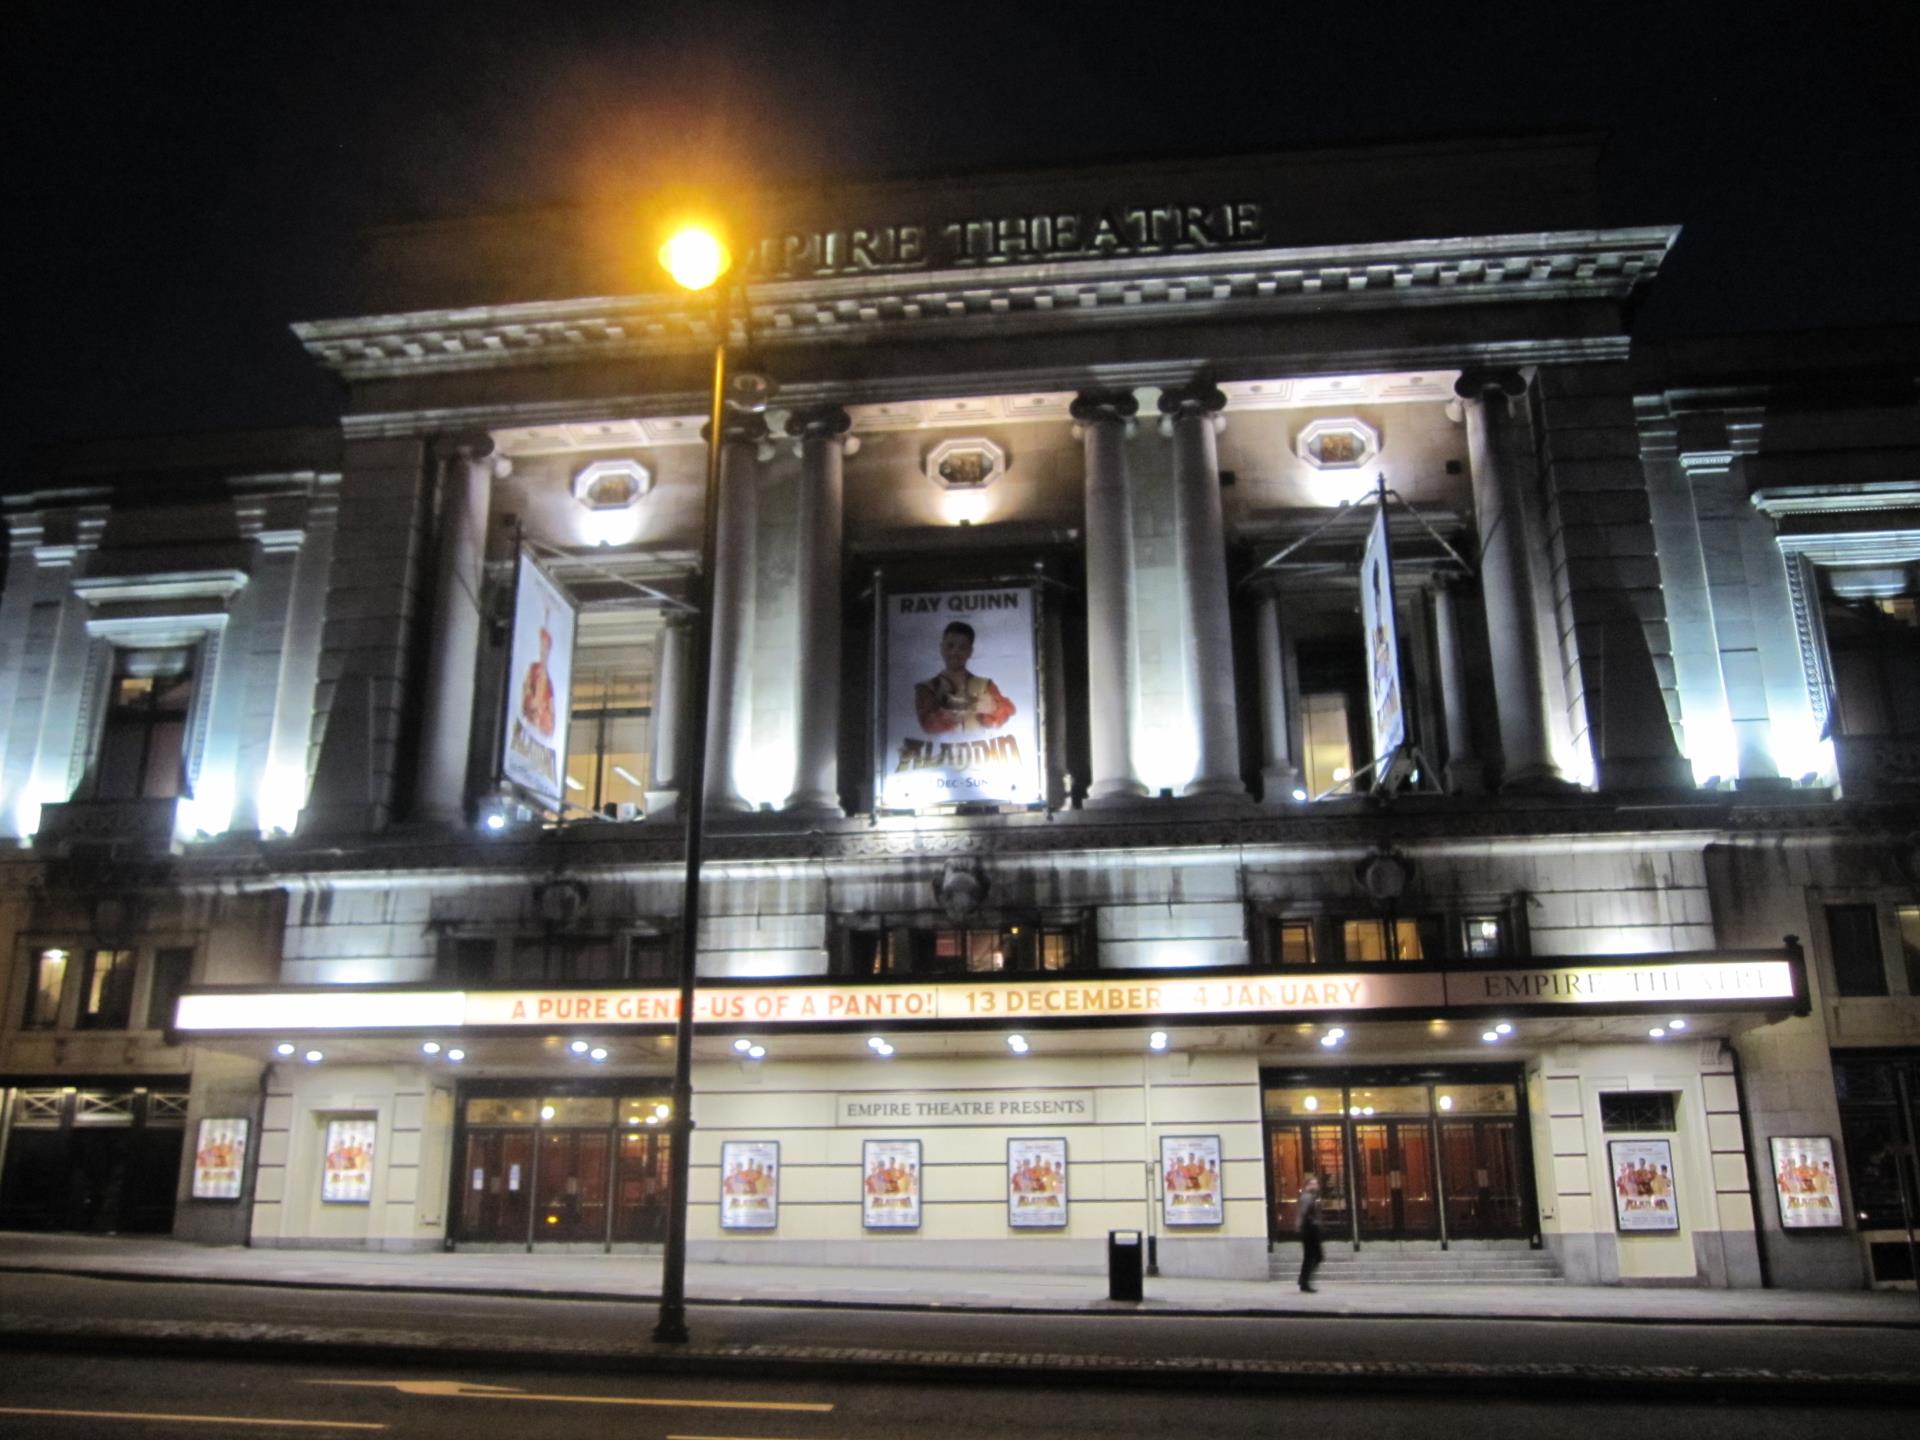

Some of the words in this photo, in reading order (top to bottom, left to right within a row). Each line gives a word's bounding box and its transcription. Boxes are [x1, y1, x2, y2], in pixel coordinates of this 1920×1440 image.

[744, 227, 928, 279] PIRE
[945, 203, 1268, 265] THEATRE
[900, 596, 942, 613] RAY
[948, 593, 1018, 612] QUINN
[895, 734, 1022, 773] ALADDIN
[967, 992, 996, 1012] 13
[1006, 988, 1161, 1012] DECEMBER
[1193, 985, 1209, 1007] 4
[1221, 982, 1362, 1007] JANUARY
[1484, 973, 1602, 998] EMPIRE
[511, 1000, 527, 1019] A
[537, 999, 608, 1019] PURE
[616, 997, 745, 1018] GENI-US
[754, 996, 790, 1017] OF
[800, 995, 816, 1015] A
[827, 993, 933, 1015] PANTO!
[846, 1103, 912, 1117] EMPIRE
[915, 1101, 995, 1116] THEATRE
[999, 1099, 1086, 1115] PRESENTS
